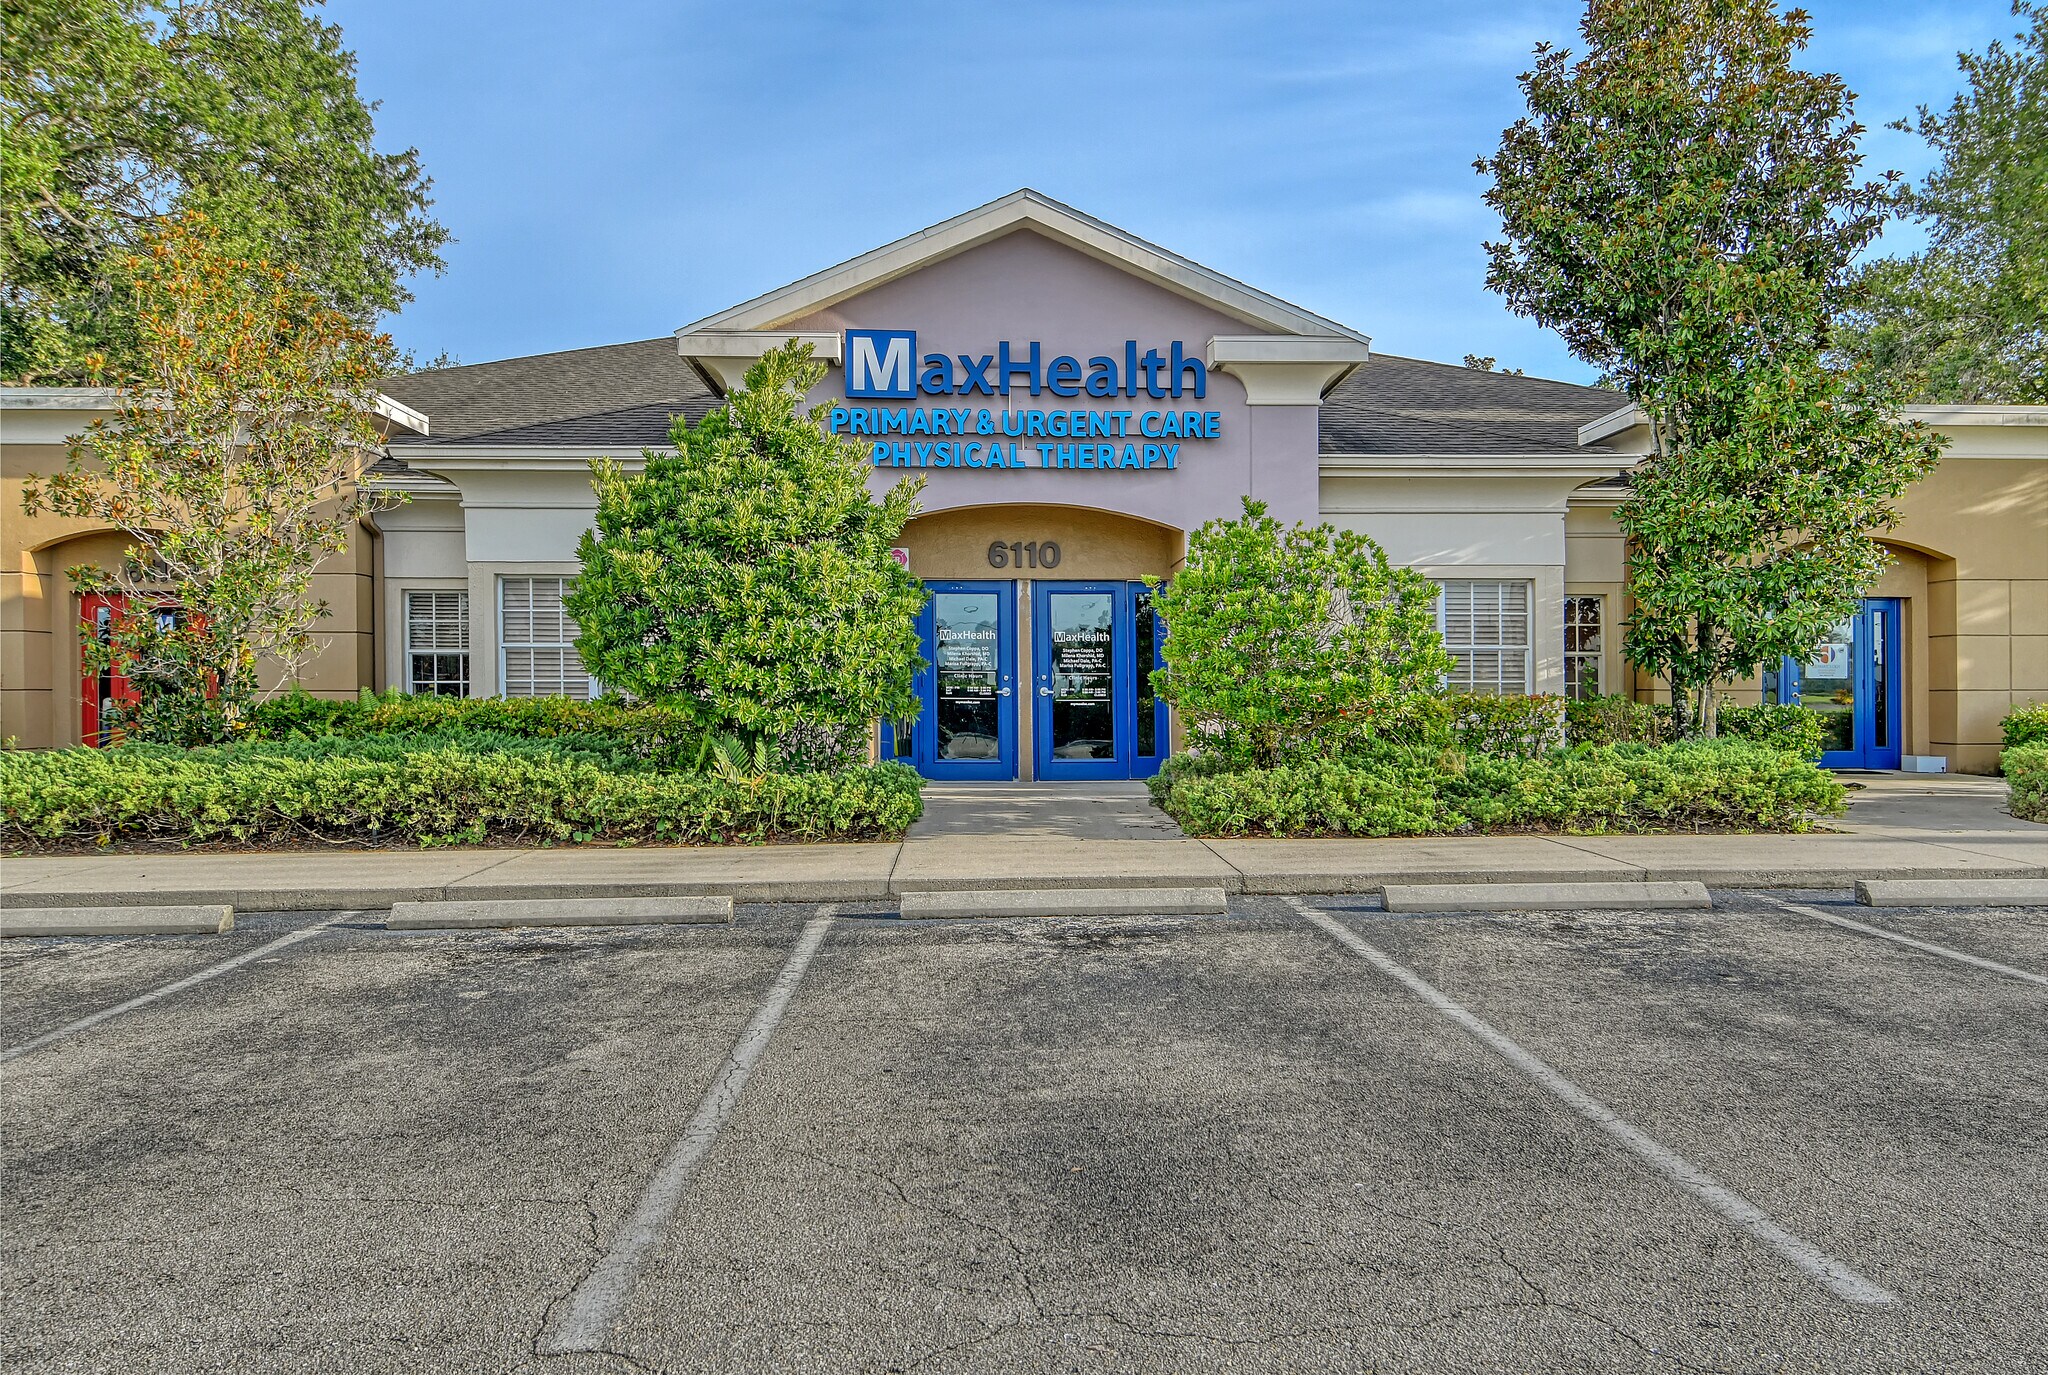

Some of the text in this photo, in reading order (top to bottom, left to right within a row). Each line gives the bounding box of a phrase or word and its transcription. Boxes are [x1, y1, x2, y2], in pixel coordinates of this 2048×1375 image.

[845, 329, 1207, 399] MaxHealth
[830, 407, 1221, 439] PRIMARY & URGENT CARE
[873, 441, 1180, 470] PHYSICAL THERAPY
[987, 541, 1062, 569] 6110
[940, 630, 996, 640] MaxHealth
[1054, 632, 1110, 642] MaxHealth
